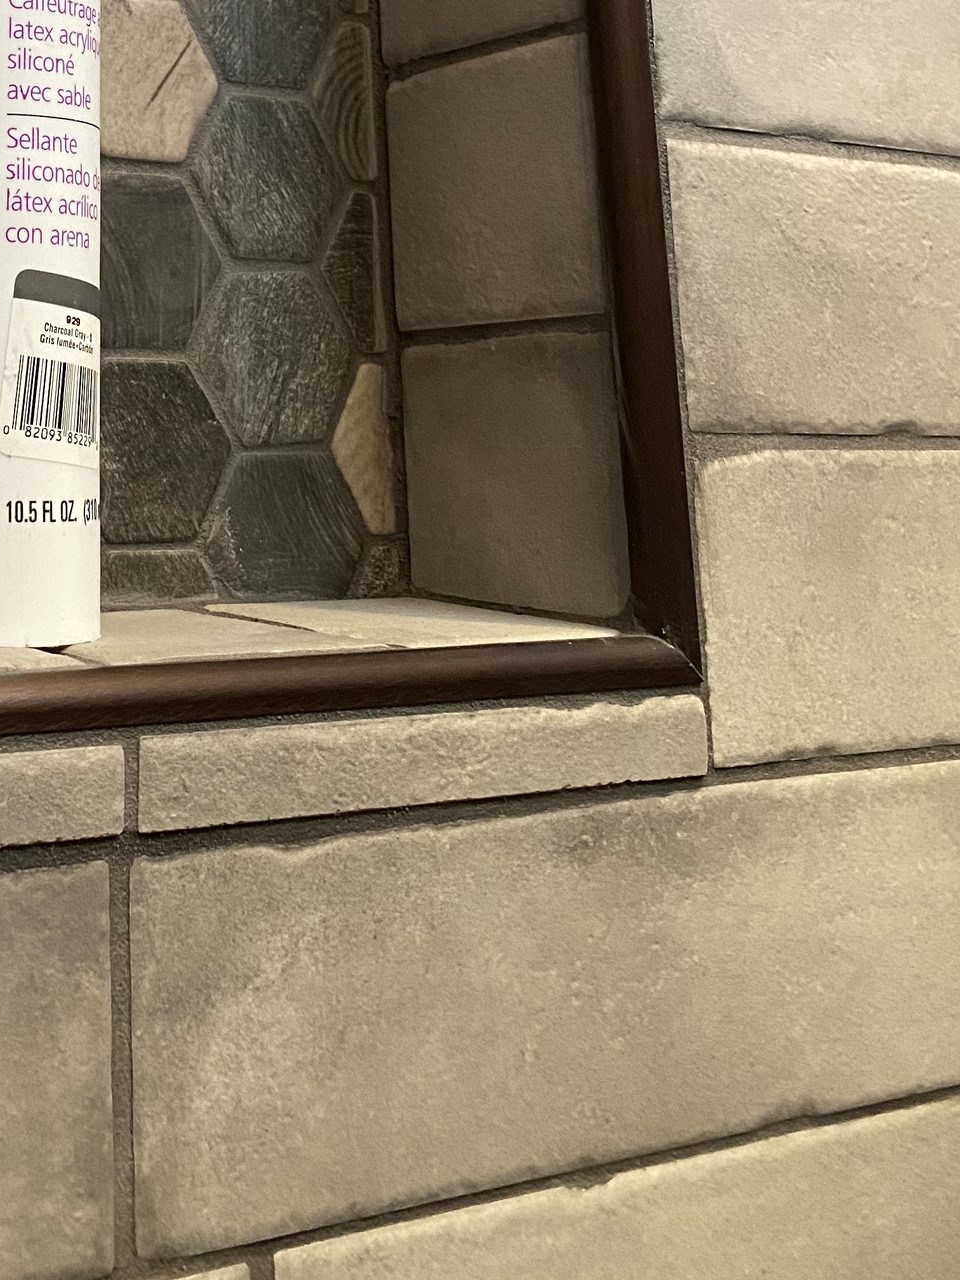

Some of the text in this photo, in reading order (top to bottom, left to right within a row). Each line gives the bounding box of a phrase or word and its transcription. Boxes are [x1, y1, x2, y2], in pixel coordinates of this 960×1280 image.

[8, 16, 54, 43] latex
[7, 47, 75, 76] siliconé
[7, 83, 91, 110] avec sable
[6, 126, 78, 155] Sellante
[5, 156, 91, 188] siliconado
[5, 187, 98, 221] látex acrílico
[5, 226, 90, 249] con arena
[39, 333, 55, 346] Gris
[43, 321, 74, 338] Charcoal
[74, 328, 86, 342] Gray
[3, 424, 10, 435] 0
[24, 426, 63, 442] 82093
[67, 431, 92, 448] 85229
[5, 500, 38, 523] 10.5
[42, 500, 57, 523] FL
[60, 499, 78, 523] OZ.
